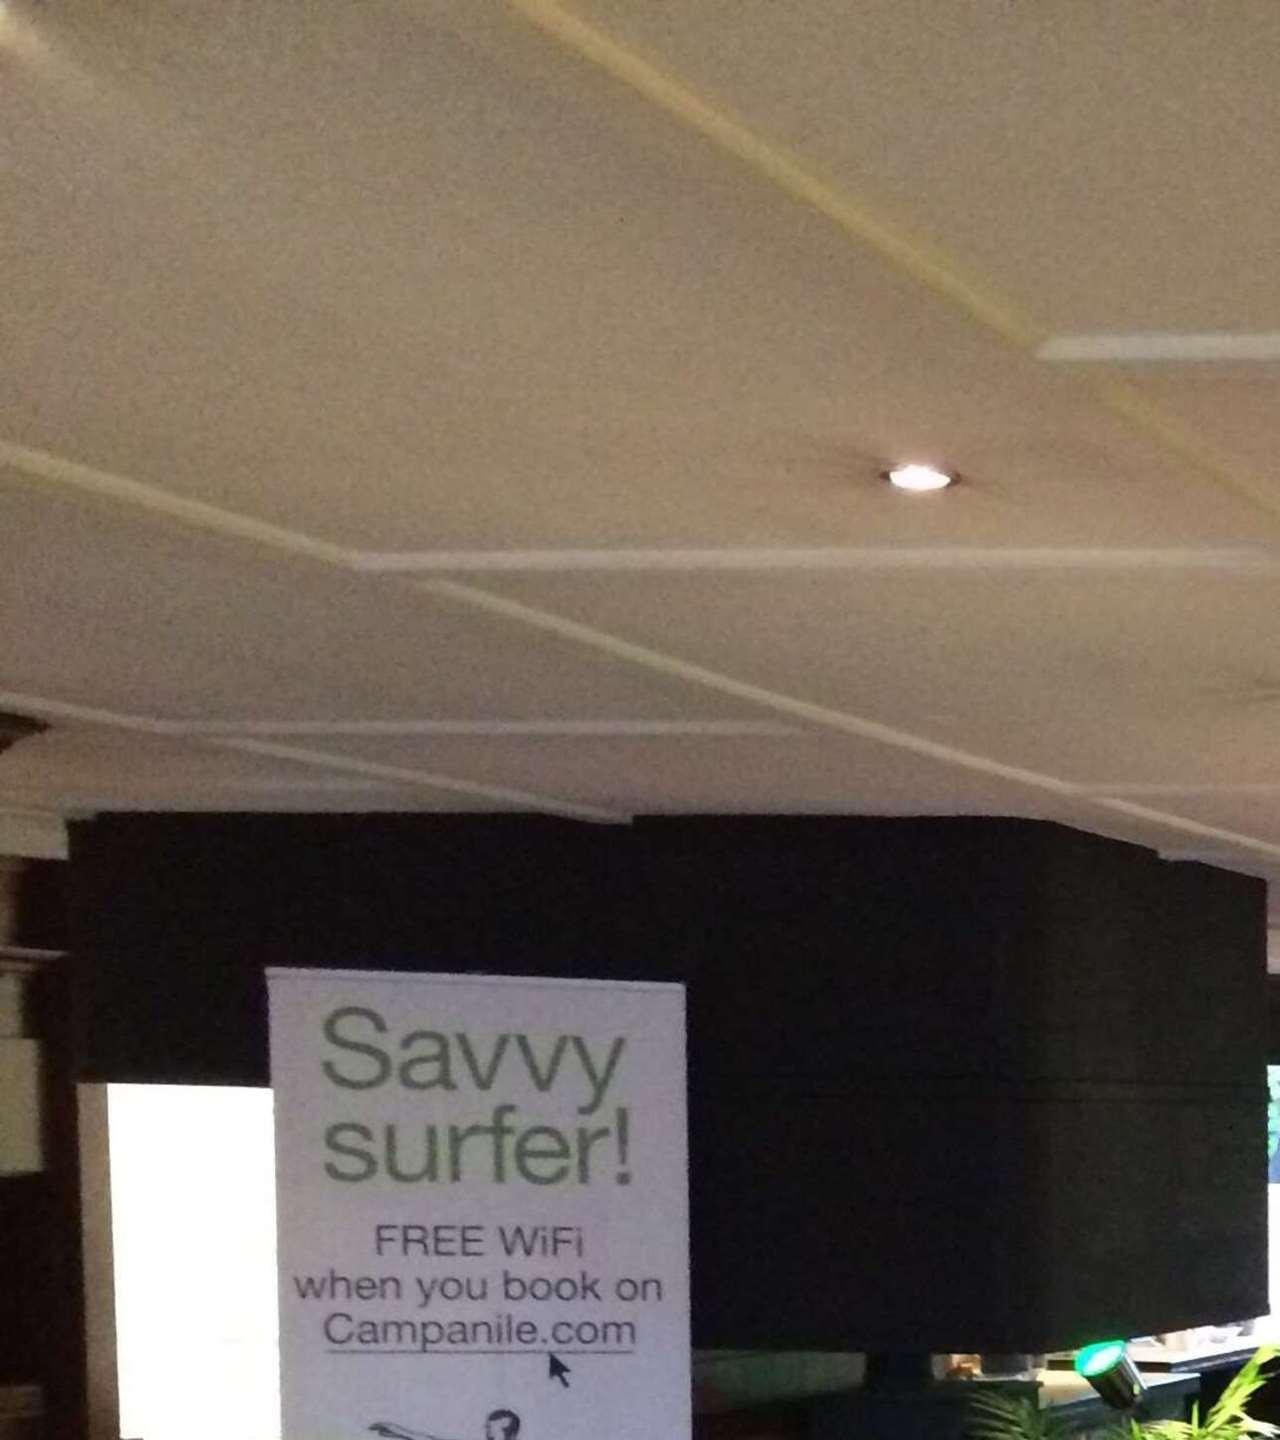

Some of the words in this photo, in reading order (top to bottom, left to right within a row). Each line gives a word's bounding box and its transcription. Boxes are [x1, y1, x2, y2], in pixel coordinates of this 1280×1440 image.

[322, 1006, 626, 1114] Savvy
[323, 1105, 631, 1186] surfer!
[375, 1224, 485, 1257] FREE
[499, 1225, 584, 1258] WiFi
[294, 1270, 400, 1300] when
[416, 1276, 487, 1307] you
[503, 1270, 602, 1301] book
[615, 1277, 663, 1301] on
[324, 1312, 636, 1351] Campanile.com
